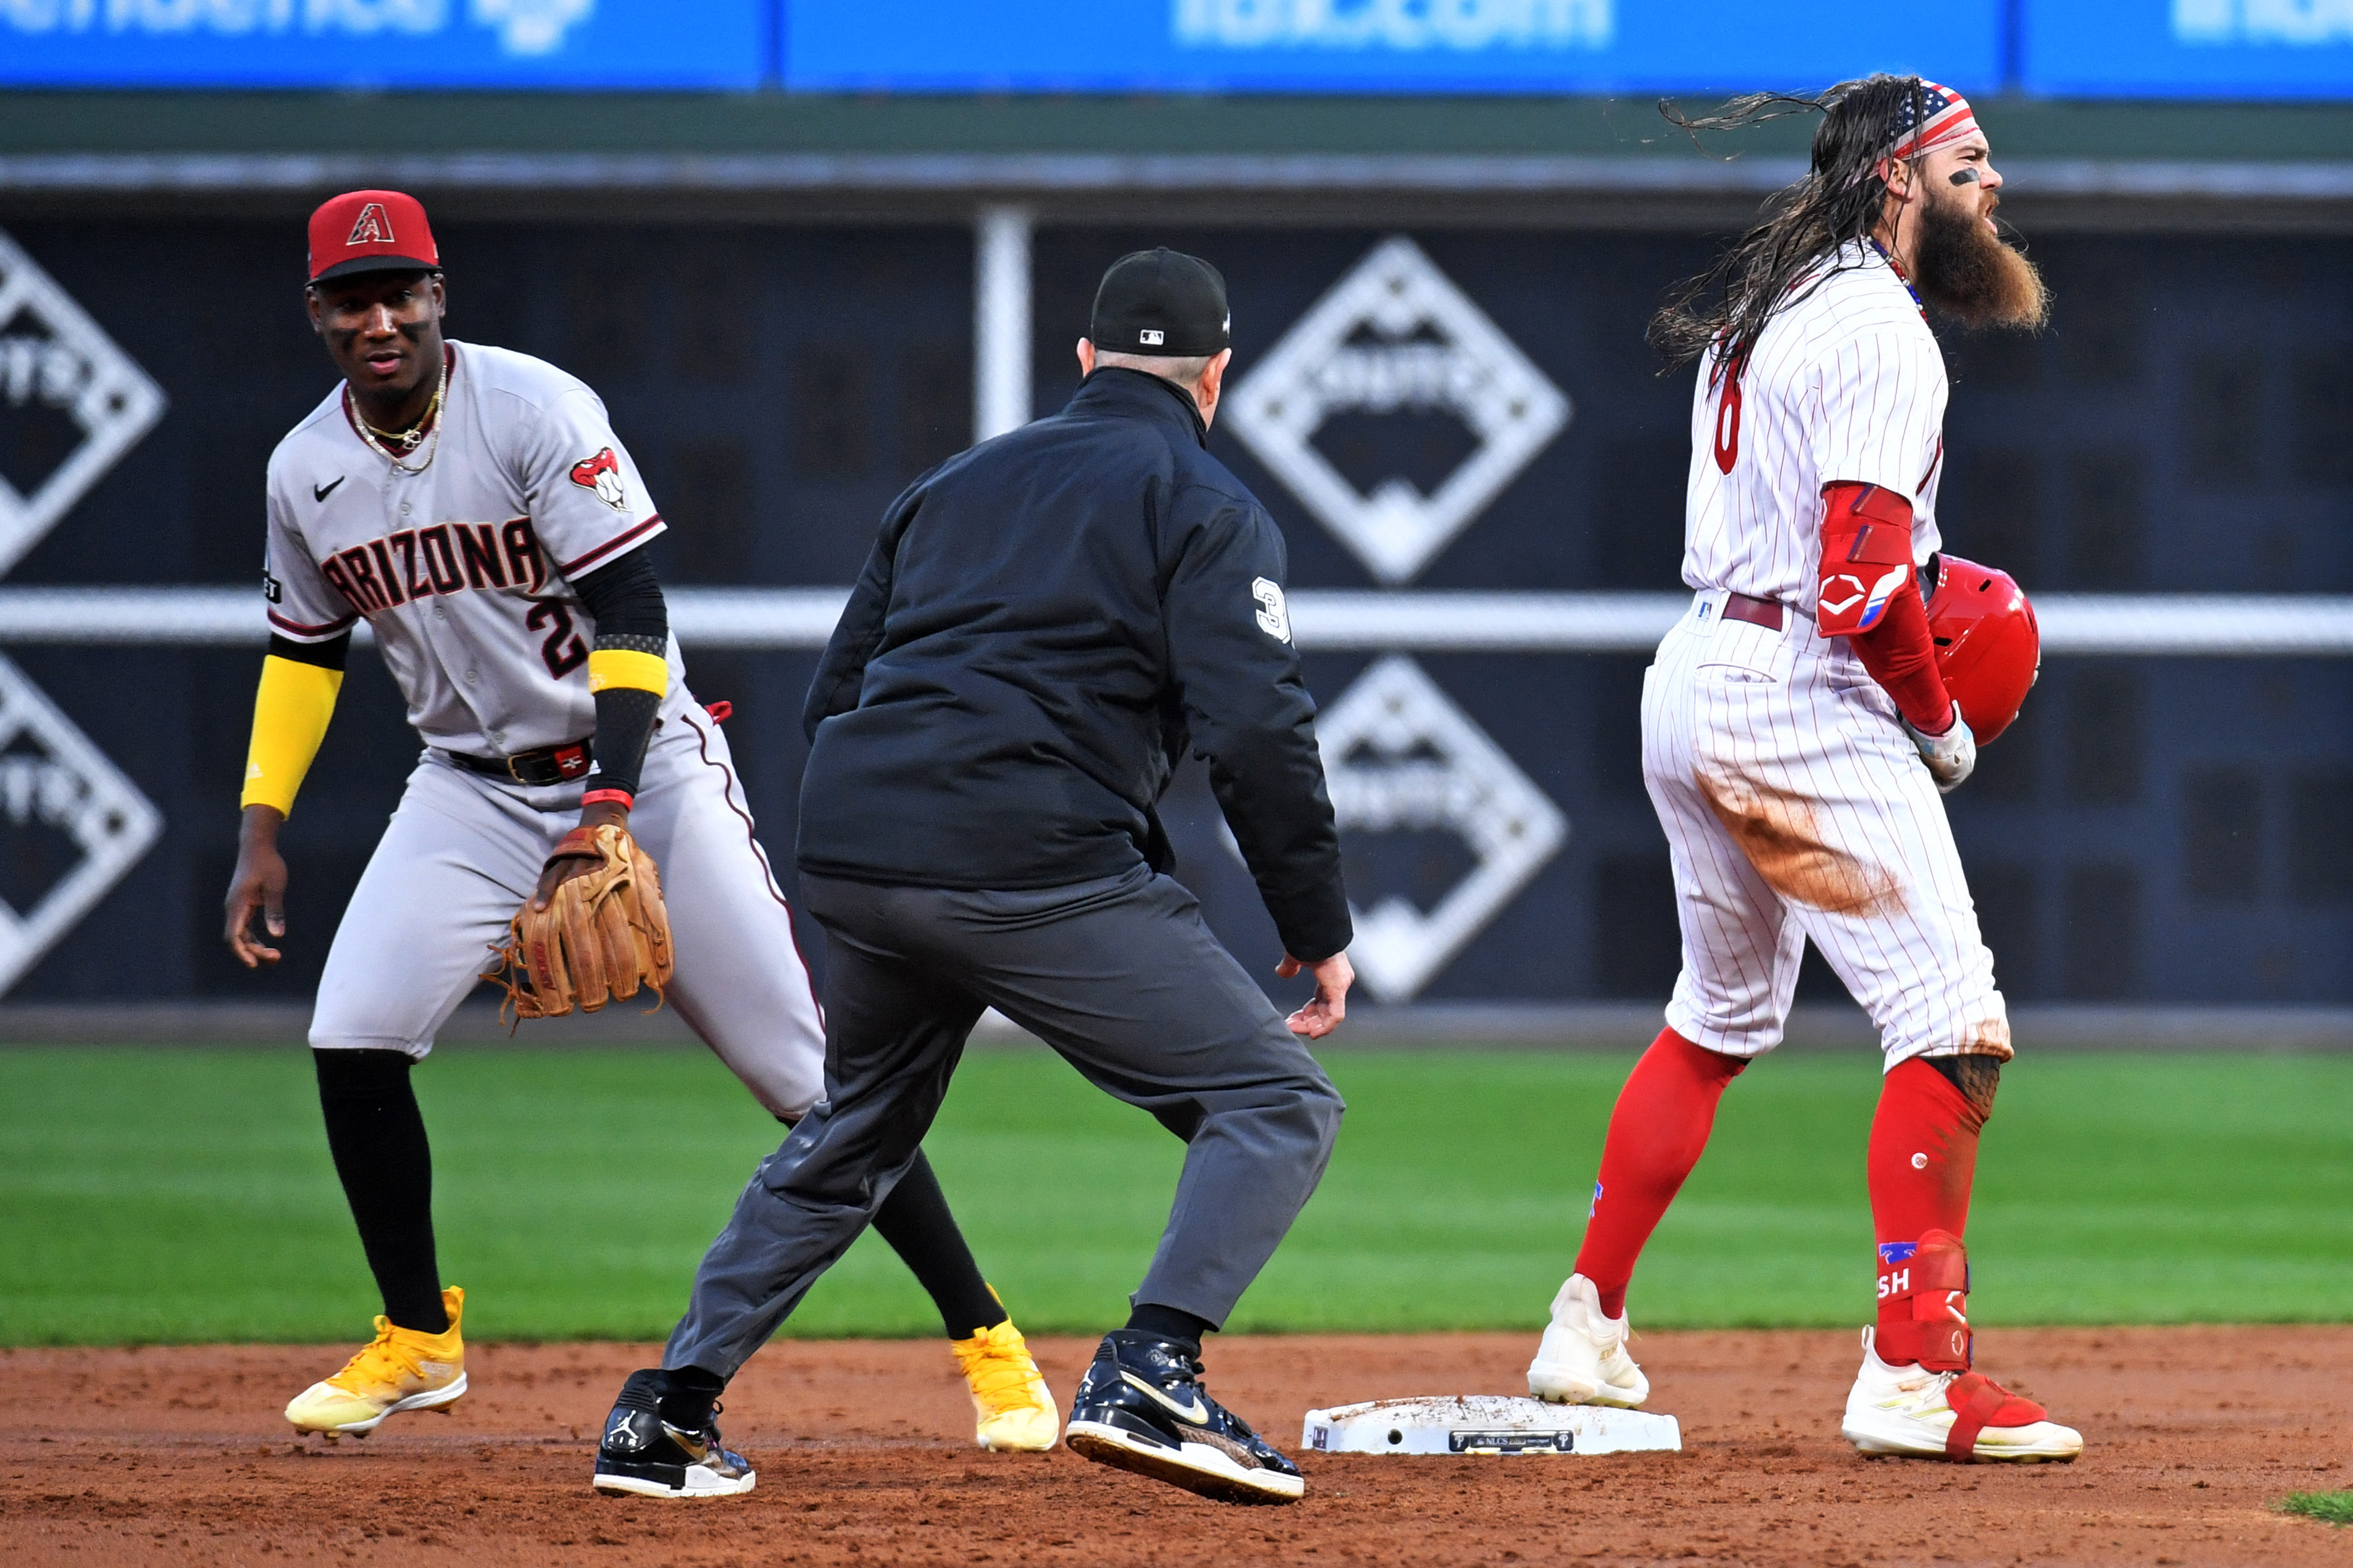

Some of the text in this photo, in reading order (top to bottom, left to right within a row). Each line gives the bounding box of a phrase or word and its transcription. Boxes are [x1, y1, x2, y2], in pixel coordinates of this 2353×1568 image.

[321, 517, 548, 621] ARIZONA
[526, 597, 590, 680] 2
[608, 1435, 637, 1446] AIR
